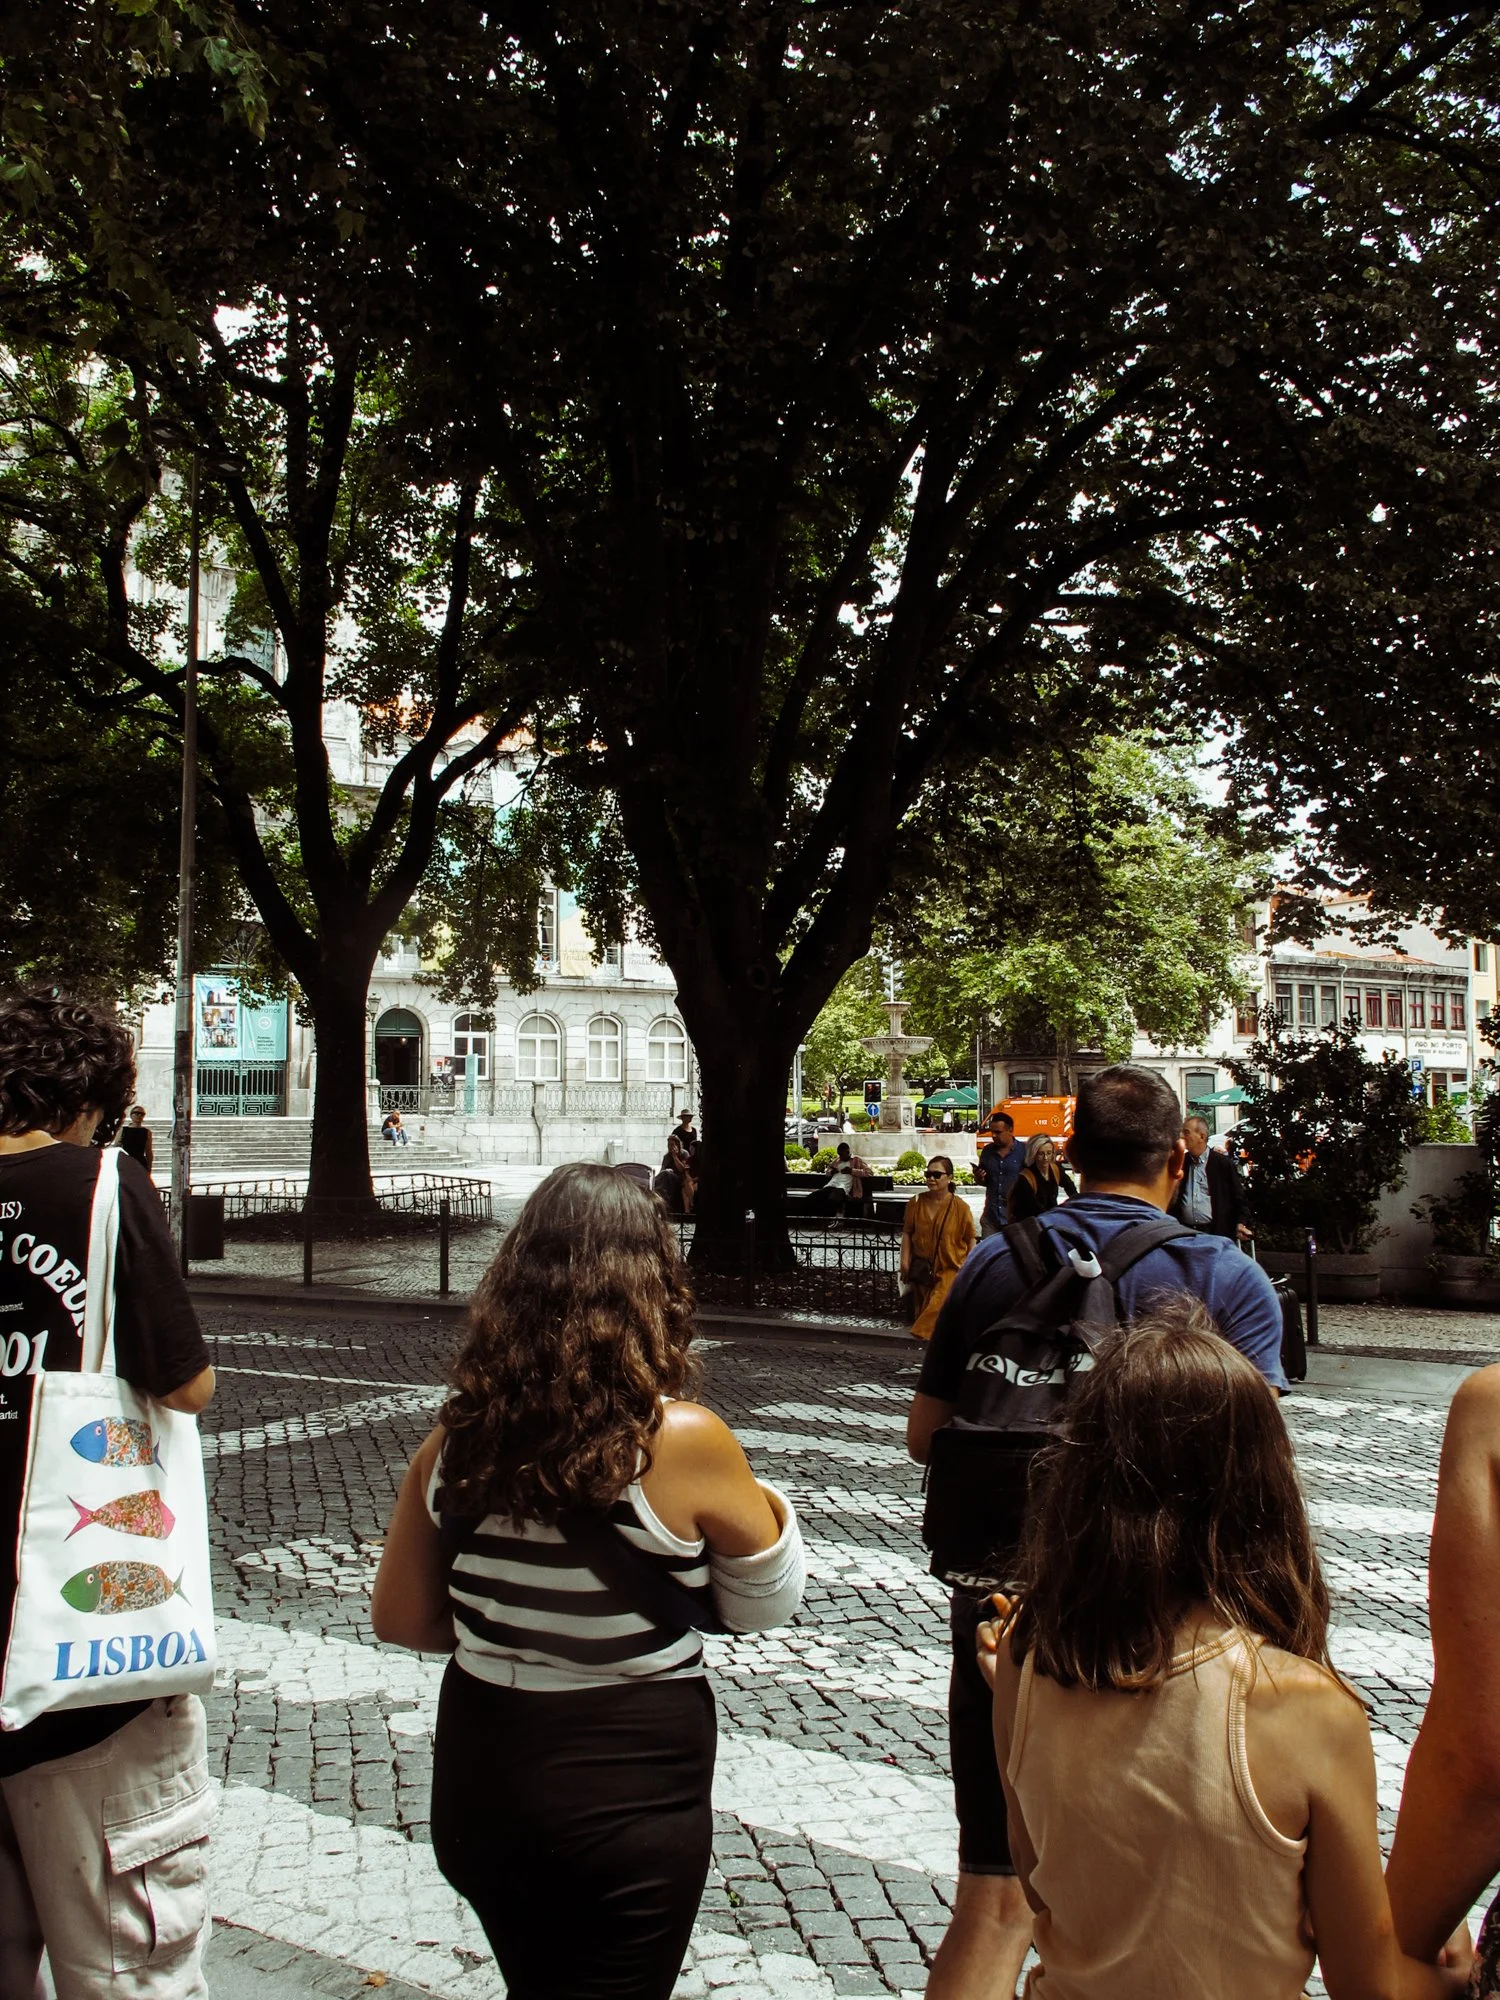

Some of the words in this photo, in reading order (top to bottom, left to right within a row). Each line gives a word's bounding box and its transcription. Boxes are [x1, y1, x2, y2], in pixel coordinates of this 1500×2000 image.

[1413, 1062, 1419, 1070] P
[0, 1201, 23, 1220] IS)
[52, 1627, 208, 1681] LISBOA
